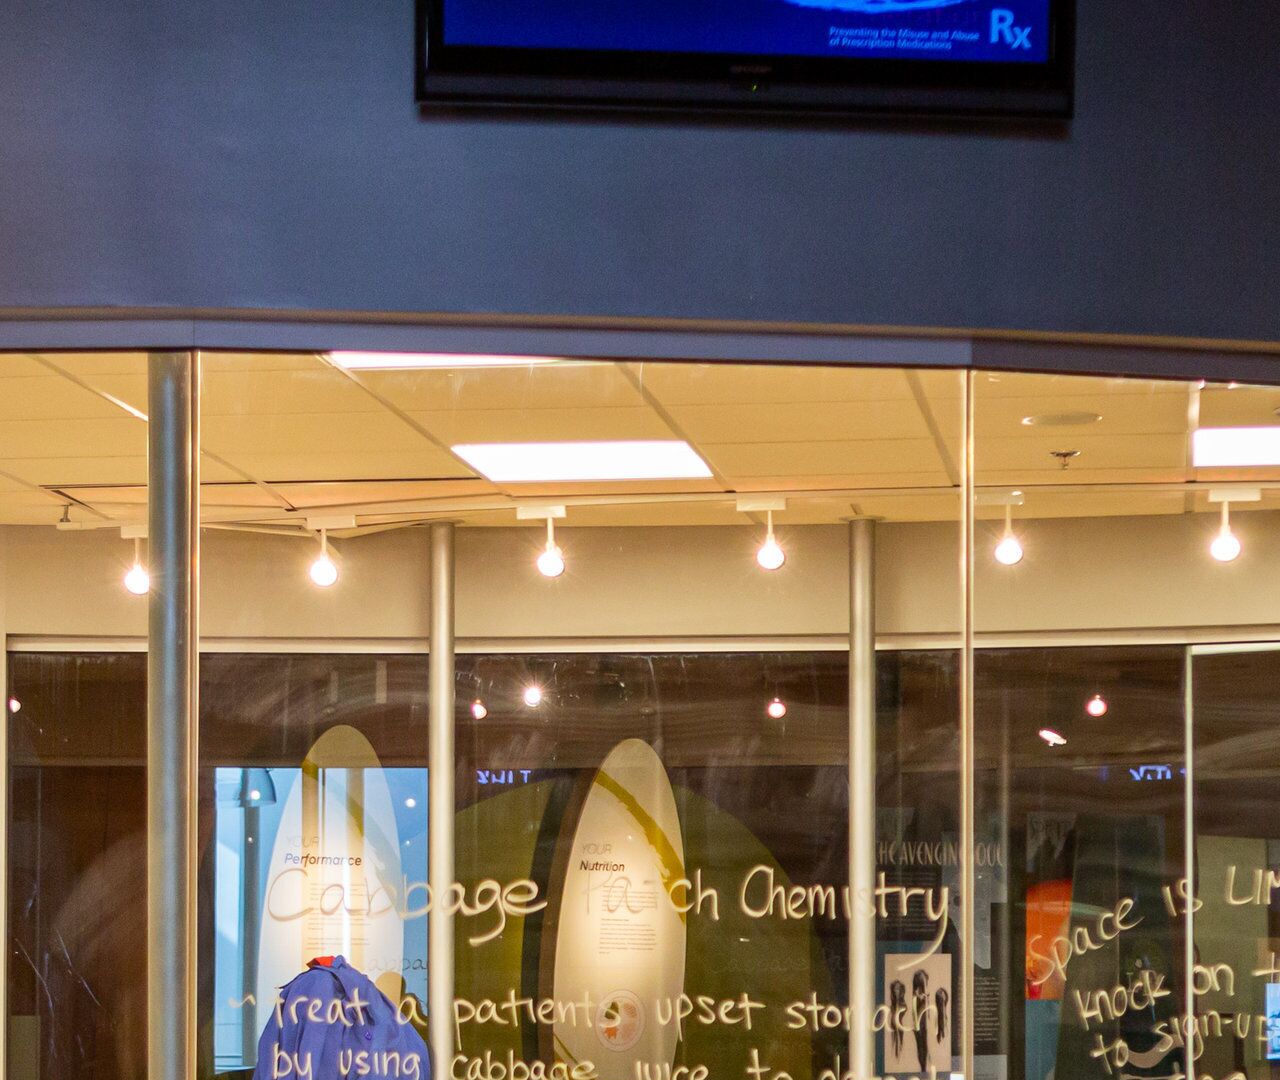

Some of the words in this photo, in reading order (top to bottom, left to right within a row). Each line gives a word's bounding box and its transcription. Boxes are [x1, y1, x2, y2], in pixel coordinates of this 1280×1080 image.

[829, 26, 879, 39] Preventing
[880, 27, 897, 38] the
[898, 28, 930, 39] Misuse
[931, 30, 949, 40] and
[950, 30, 980, 41] Abuse
[989, 8, 1032, 50] Rx
[579, 860, 626, 872] Nutrition
[267, 866, 548, 946] Cabbage
[580, 865, 720, 923] Pach
[740, 863, 951, 970] Chemistry
[1191, 962, 1235, 996] on
[655, 992, 767, 1046] upset
[1090, 1033, 1130, 1075] to
